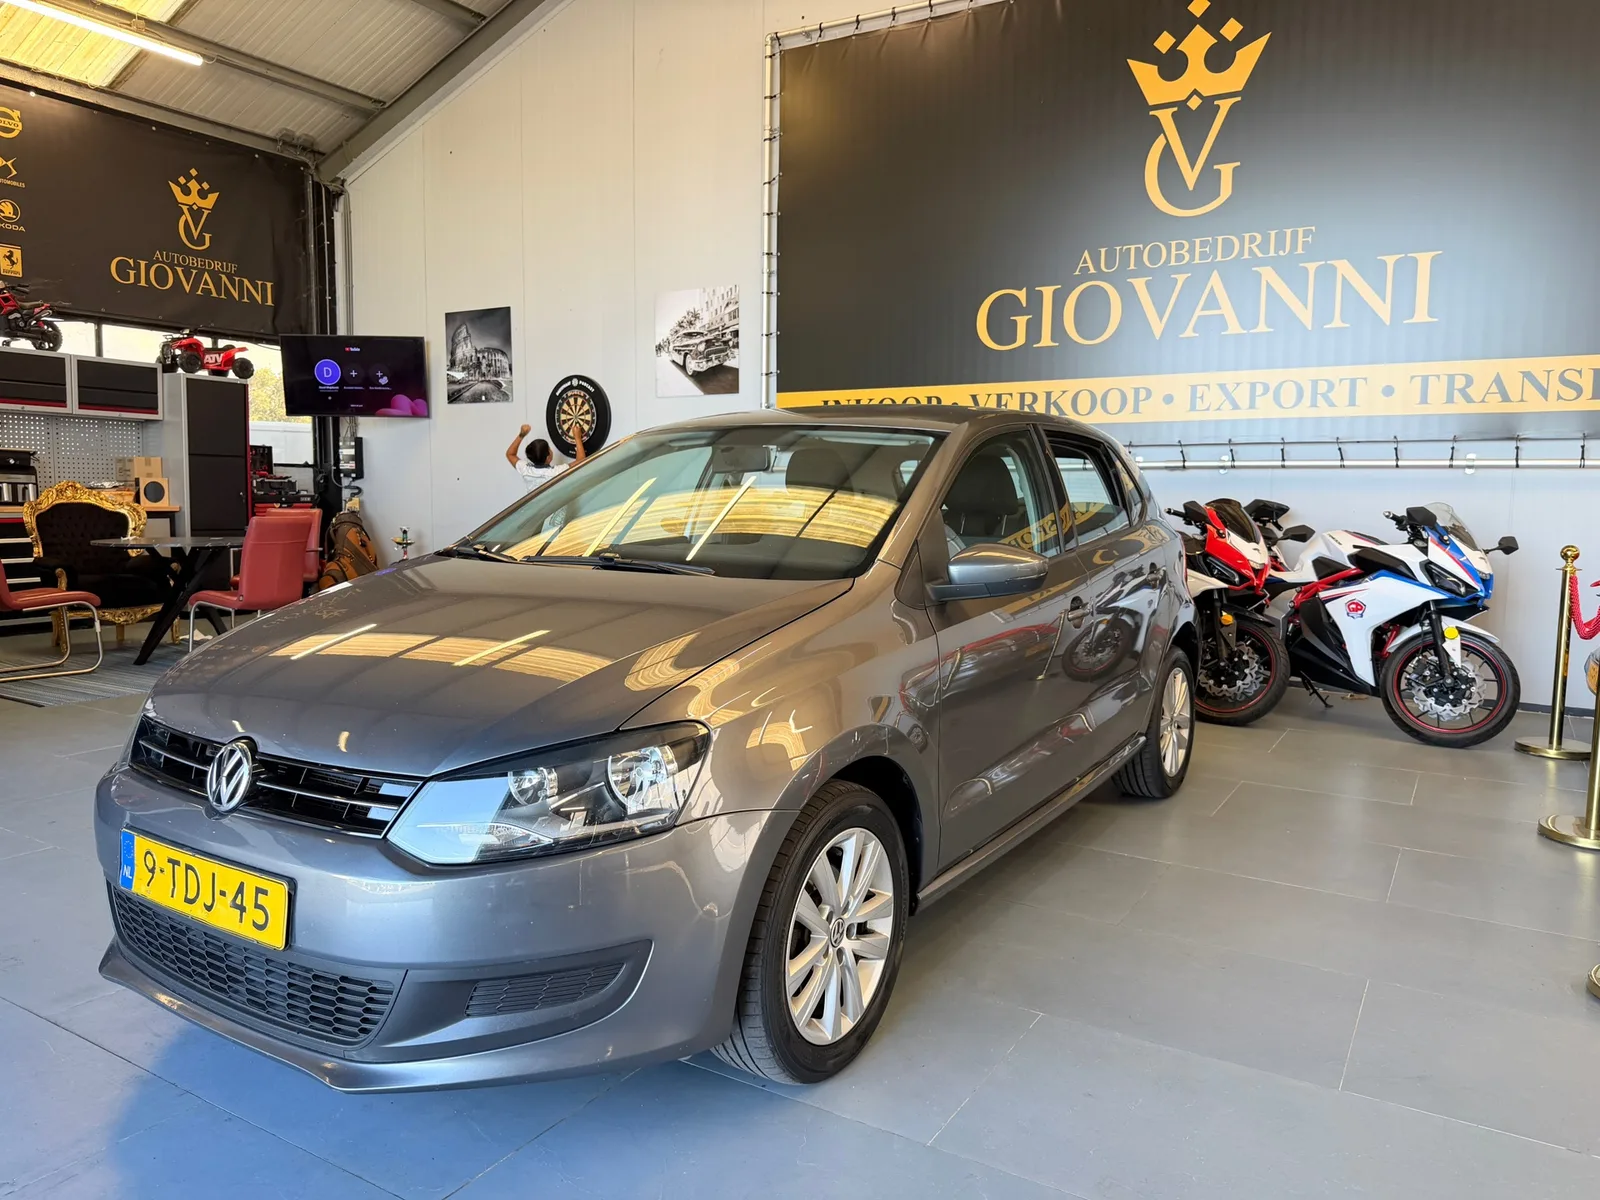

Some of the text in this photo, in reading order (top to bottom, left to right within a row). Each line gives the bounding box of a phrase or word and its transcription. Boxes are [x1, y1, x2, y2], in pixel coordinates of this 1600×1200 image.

[153, 250, 238, 274] AUTOBEDRIJF
[1073, 226, 1316, 276] AUTOBEDRIJF
[110, 256, 275, 306] GIOVANNI
[976, 251, 1443, 351] GIOVANNI
[204, 353, 223, 364] ATV
[323, 367, 332, 378] D
[1186, 376, 1368, 413] EXPORT
[122, 863, 133, 880] NL
[143, 850, 270, 932] 9-TDJ-45
